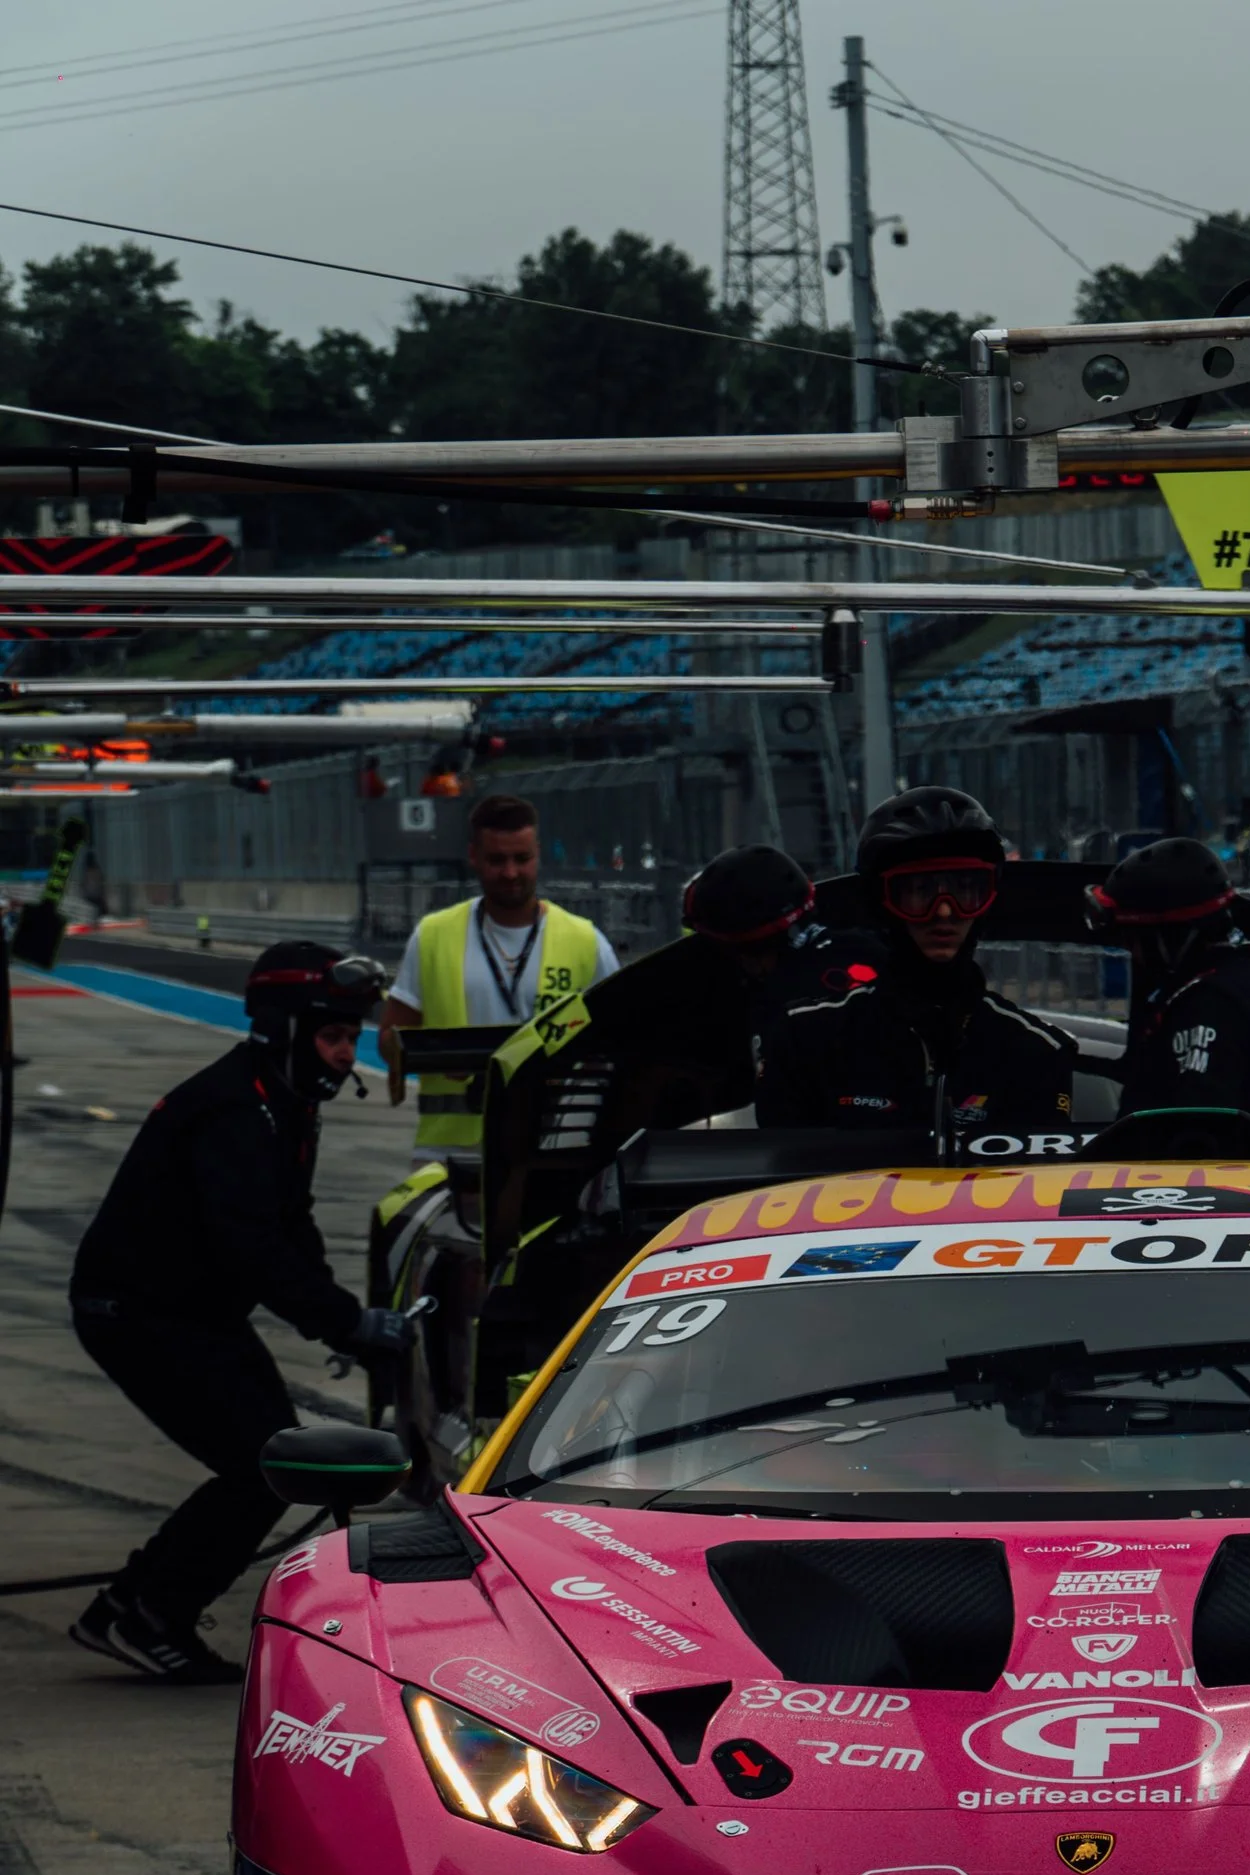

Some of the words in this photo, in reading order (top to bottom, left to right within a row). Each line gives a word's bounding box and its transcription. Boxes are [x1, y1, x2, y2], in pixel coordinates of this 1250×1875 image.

[545, 968, 572, 991] 58
[661, 1264, 734, 1288] PRO
[605, 1298, 727, 1355] 19
[540, 1509, 677, 1577] #OMZexperience
[1023, 1545, 1084, 1553] CALDAIE
[1125, 1543, 1191, 1551] MELGARI
[1051, 1582, 1157, 1595] METALLI
[1056, 1571, 1160, 1583] BIANCHI
[601, 1599, 702, 1654] SESSANTINI
[629, 1630, 679, 1659] IMPIANTI
[1088, 1638, 1126, 1653] FV
[1002, 1666, 1196, 1690] VANOLI
[797, 1739, 925, 1771] RGM
[957, 1785, 1220, 1809] gieffeacciai.it
[1060, 1834, 1110, 1842] LAMBORGHINI
